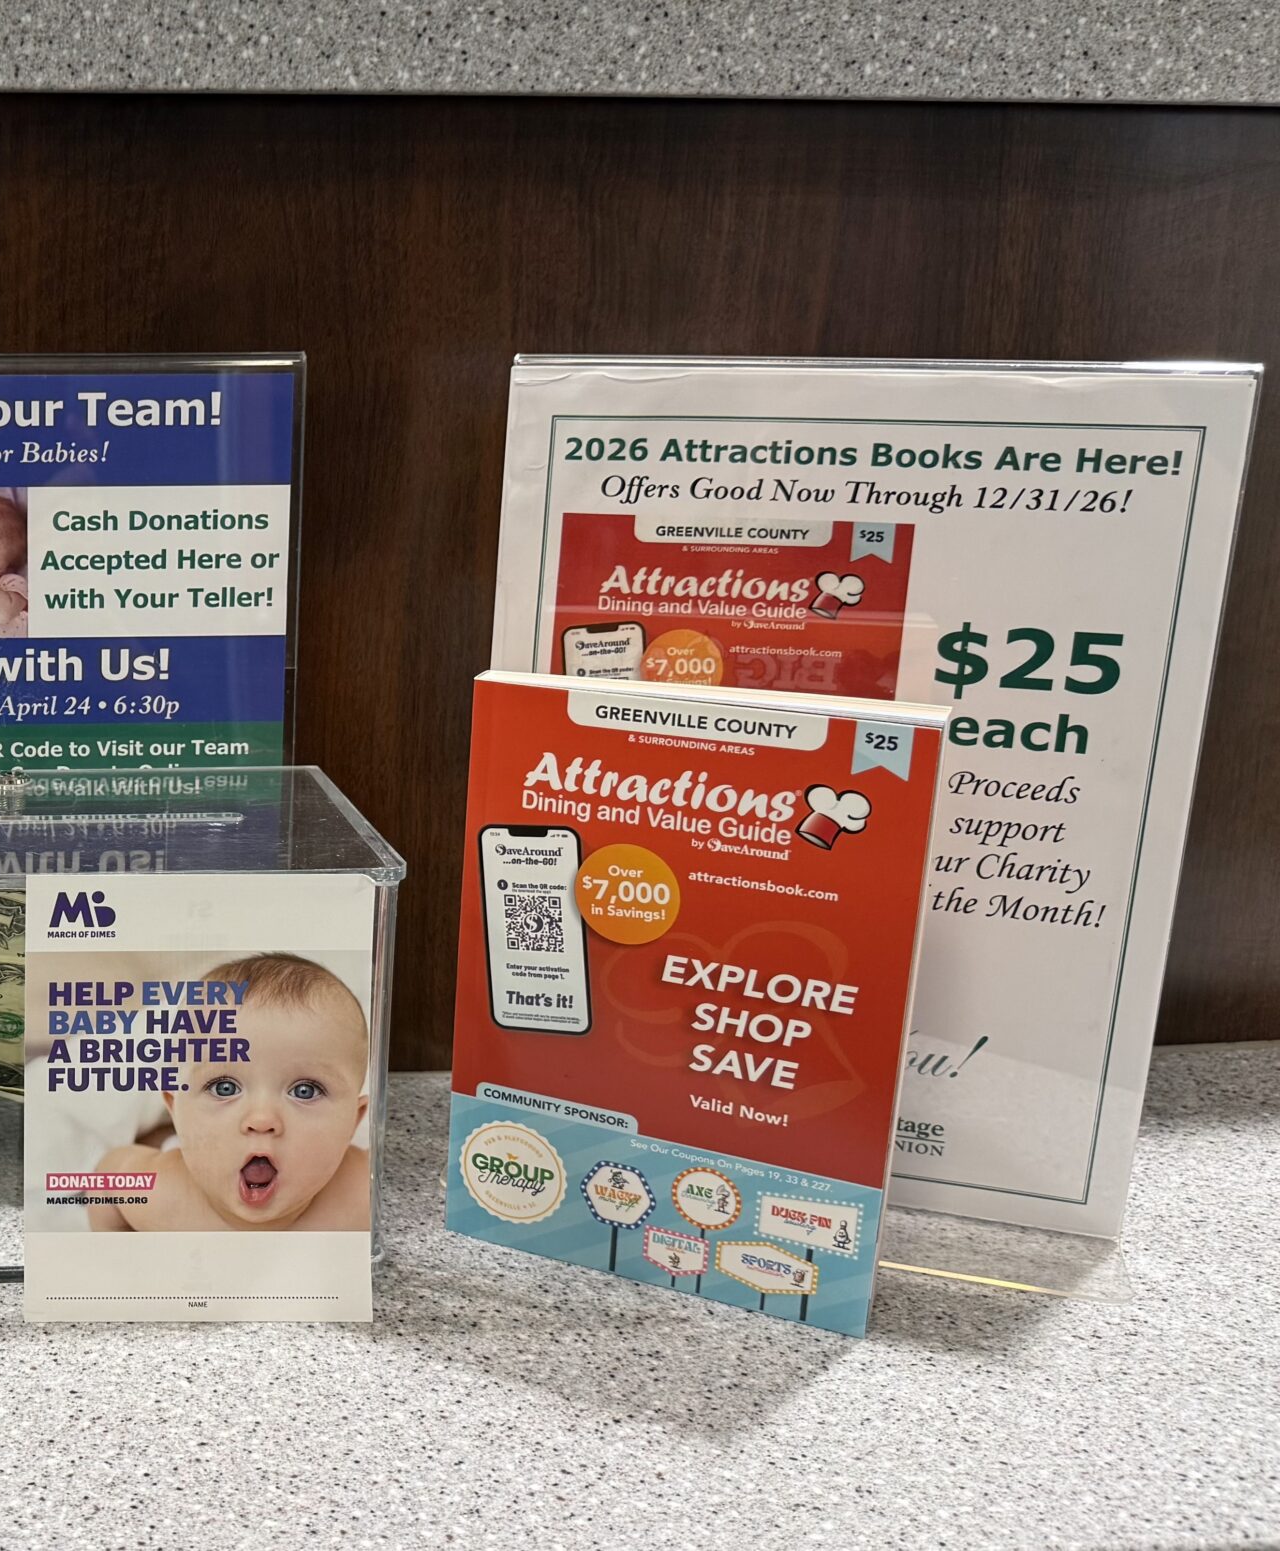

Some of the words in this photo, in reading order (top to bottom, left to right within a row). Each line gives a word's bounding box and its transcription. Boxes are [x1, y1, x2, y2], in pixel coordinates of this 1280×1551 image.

[77, 391, 222, 427] Team!
[19, 441, 110, 464] Babies!
[564, 438, 648, 462] 2026
[659, 437, 857, 467] Attractions
[870, 442, 982, 471] Books
[995, 446, 1061, 473] Are
[1076, 447, 1183, 476] Here!
[600, 474, 681, 502] Offers
[687, 476, 762, 502] Good
[769, 479, 836, 503] Now
[845, 481, 963, 513] Through
[974, 485, 1134, 514] 12/31/26!
[52, 510, 119, 532] Cash
[128, 509, 269, 532] Donations
[655, 525, 743, 539] GREENVILLE
[747, 527, 809, 540] COUNTY
[859, 529, 885, 543] $25
[40, 549, 167, 578] Accepted
[177, 549, 242, 571] Here
[250, 553, 280, 570] or
[44, 587, 105, 610] with
[114, 588, 179, 609] Your
[187, 587, 274, 608] Teller!
[599, 565, 810, 603] Attractions
[598, 596, 654, 616] Dining
[697, 599, 747, 617] Value
[751, 602, 807, 619] Guide
[100, 647, 171, 681] Us!
[729, 644, 842, 659] attractionsbook.com
[934, 622, 1124, 700] $25
[646, 657, 716, 680] $7,000
[64, 697, 91, 716] 24
[113, 695, 180, 720] 6:30p
[594, 704, 708, 731] GREENVILLE
[713, 717, 798, 740] COUNTY
[10, 741, 63, 758] Code
[68, 743, 91, 758] to
[97, 740, 144, 757] Visit
[149, 742, 186, 757] our
[191, 739, 250, 756] Team
[638, 735, 717, 752] SURROUNDING
[719, 744, 755, 756] AREAS
[865, 731, 899, 752] $25
[948, 713, 1089, 755] each
[524, 752, 796, 822] Attractions
[948, 770, 1080, 804] Proceeds
[521, 790, 592, 823] Dining
[596, 800, 641, 826] and
[647, 805, 712, 835] Value
[717, 815, 792, 846] Guide
[949, 815, 1066, 847] support
[608, 864, 644, 879] Over
[934, 853, 970, 874] ur
[976, 851, 1091, 894] Charity
[581, 875, 671, 906] $7,000
[687, 871, 839, 902] attractionsbook.com
[590, 904, 604, 917] in
[606, 905, 667, 923] Savings!
[931, 886, 978, 915] the
[986, 894, 1106, 929] Month!
[47, 931, 77, 939] MARCH
[90, 930, 116, 938] DIMES
[506, 963, 522, 971] Enter
[538, 965, 570, 973] activation
[48, 981, 134, 1006] HELP
[142, 981, 249, 1005] EVERY
[661, 954, 859, 1015] EXPLORE
[506, 990, 553, 1008] That's
[555, 993, 574, 1009] it!
[48, 1010, 138, 1035] BABY
[146, 1009, 237, 1034] HAVE
[690, 1002, 812, 1048] SHOP
[47, 1039, 71, 1064] A
[79, 1038, 251, 1063] BRIGHTER
[48, 1067, 189, 1092] FUTURE.
[688, 1044, 799, 1090] SAVE
[483, 1088, 562, 1114] COMMUNITY
[563, 1105, 629, 1130] SPONSOR:
[689, 1094, 734, 1116] Valid
[739, 1105, 789, 1127] Now!
[472, 1152, 555, 1184] GROUP
[630, 1139, 648, 1151] See
[650, 1143, 670, 1155] Our
[671, 1147, 715, 1168] Coupons
[717, 1158, 733, 1170] On
[735, 1162, 765, 1178] Pages
[785, 1174, 798, 1185] 33
[800, 1177, 810, 1187] &
[49, 1175, 105, 1189] DONATE
[107, 1174, 153, 1188] TODAY
[478, 1168, 546, 1197] Therapy
[46, 1196, 148, 1205] MARCHOFDIMES.ORG
